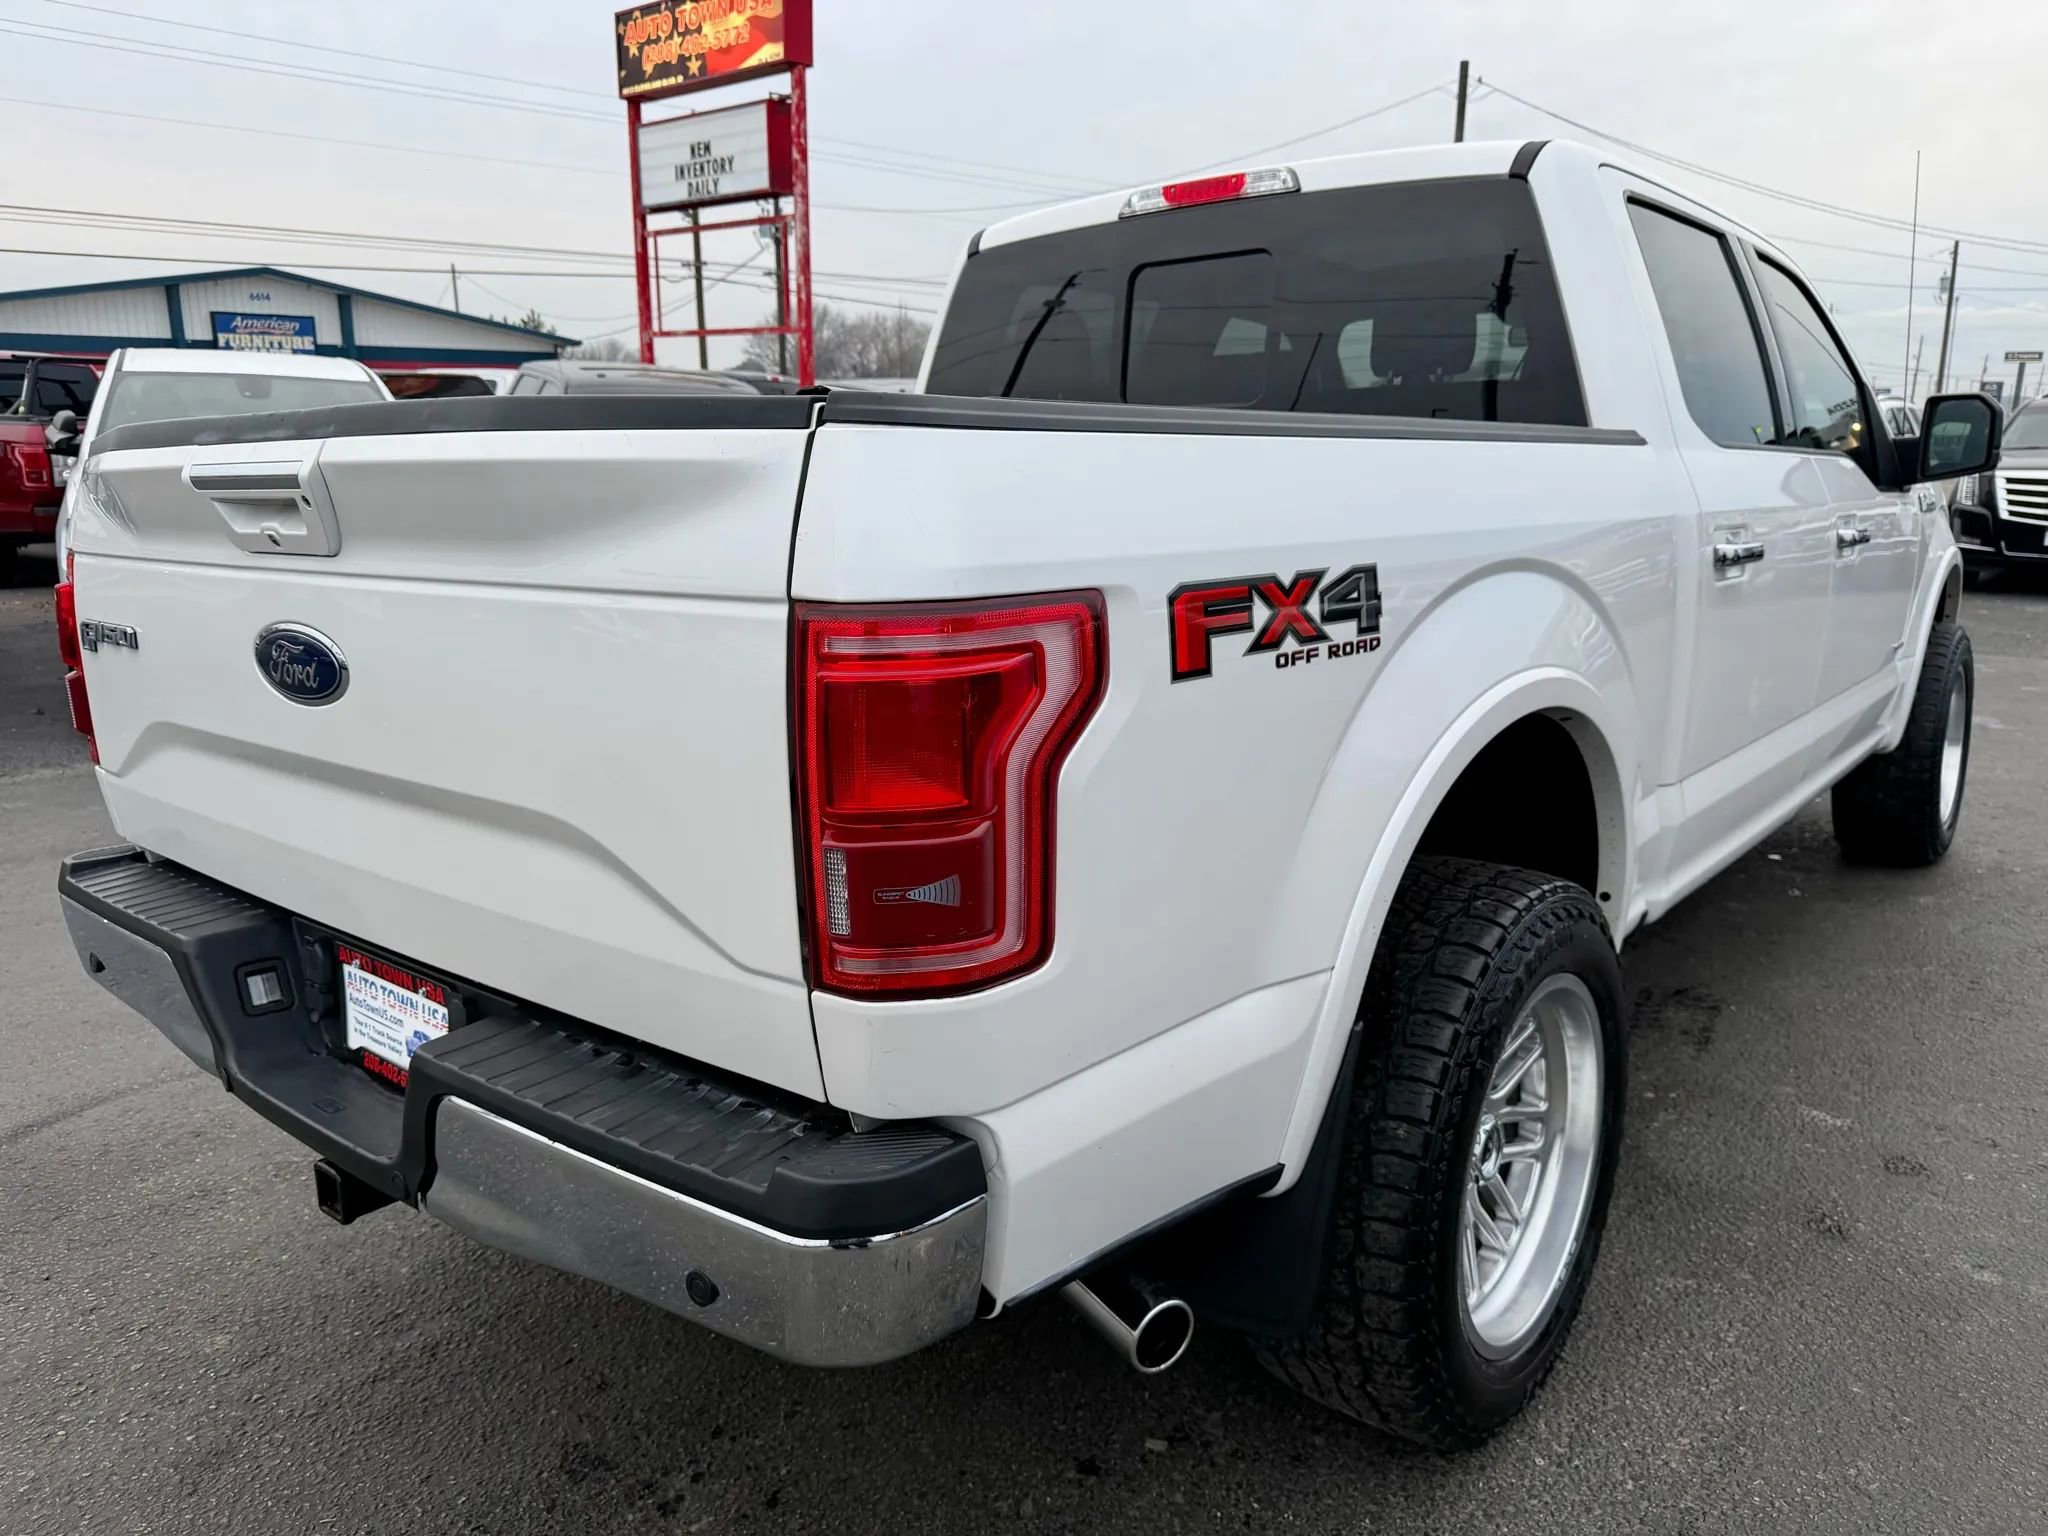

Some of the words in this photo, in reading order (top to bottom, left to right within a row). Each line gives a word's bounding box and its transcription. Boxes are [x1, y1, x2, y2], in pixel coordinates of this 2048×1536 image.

[624, 11, 672, 46] AUTO
[675, 0, 731, 33] TOWN
[675, 154, 734, 182] INVENTORY
[688, 177, 719, 198] DAILY
[217, 333, 314, 350] FURNITURE
[230, 316, 300, 332] American
[1166, 562, 1383, 684] FX4
[269, 640, 320, 688] Ford
[1275, 647, 1320, 669] OFF
[1327, 636, 1382, 660] ROAD
[338, 946, 372, 974] AUTO
[375, 960, 413, 991] TOWN
[415, 977, 446, 1006] USA
[347, 970, 379, 1000] AUTO
[380, 985, 419, 1019] TOWN
[421, 1003, 449, 1030] USA
[363, 1051, 408, 1088] 208-402-5
